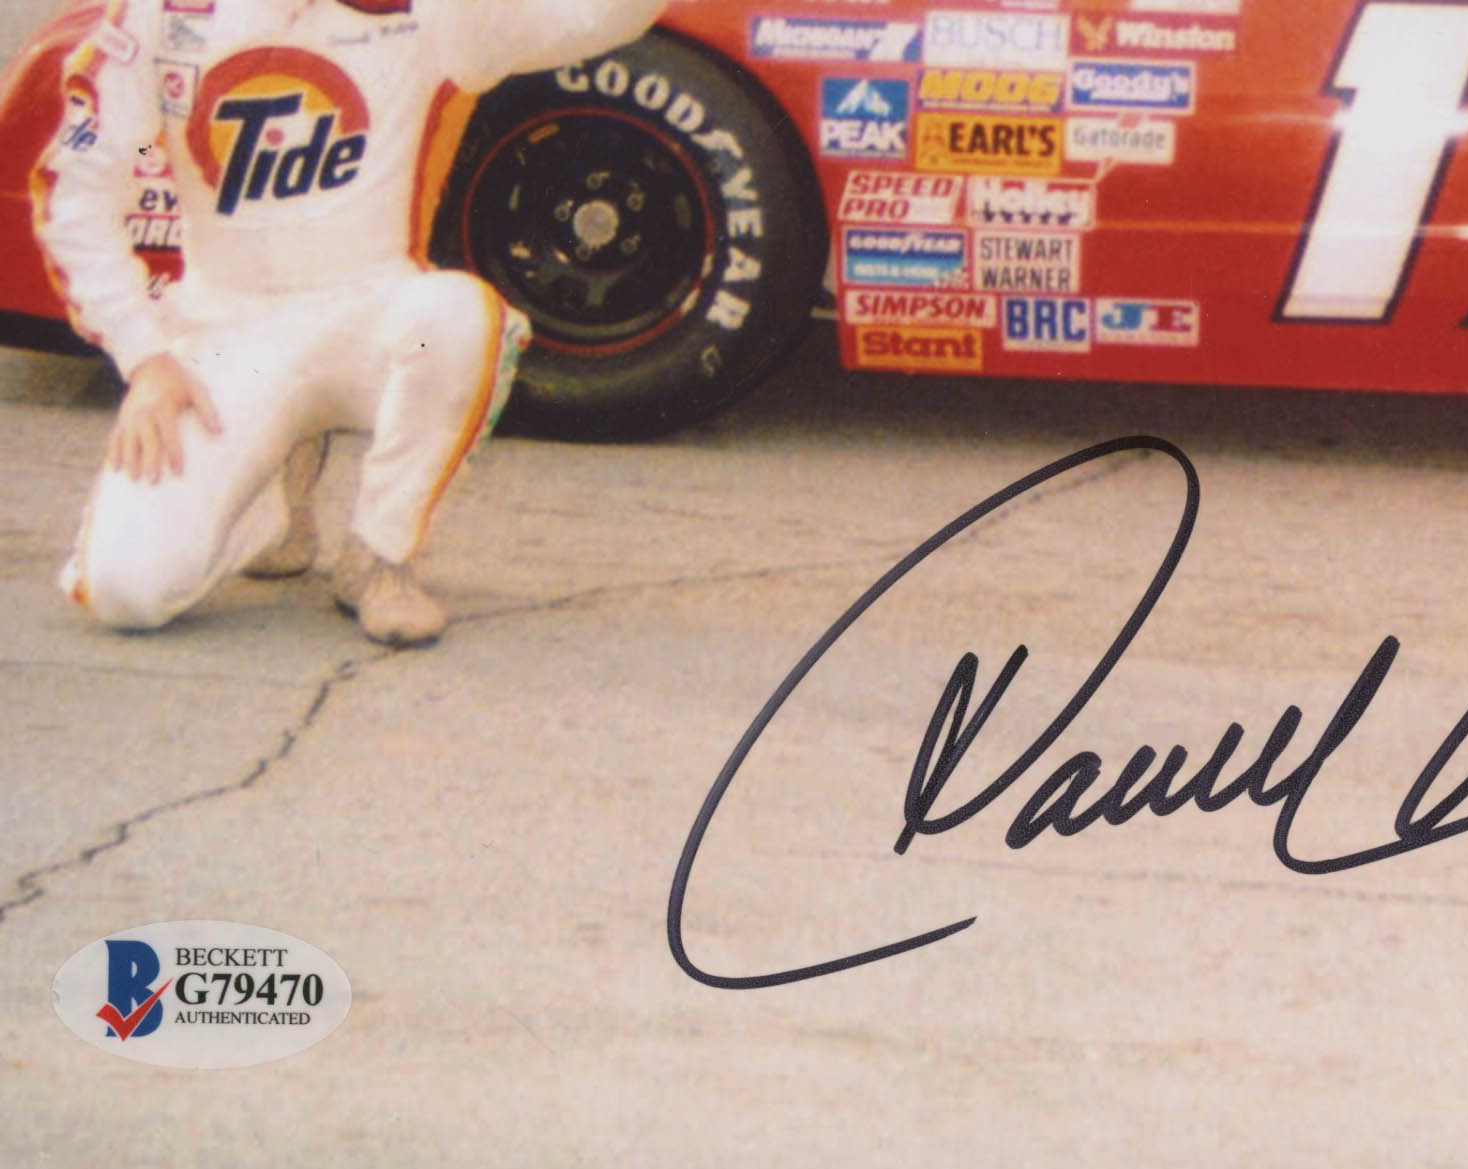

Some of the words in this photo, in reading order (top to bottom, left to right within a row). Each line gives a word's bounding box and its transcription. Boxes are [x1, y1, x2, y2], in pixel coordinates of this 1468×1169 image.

[931, 16, 1064, 51] BUSCH
[1115, 21, 1236, 51] Winston
[920, 71, 1062, 104] MOOG
[822, 119, 906, 151] PEAK
[949, 122, 1055, 157] EARL'S
[1072, 125, 1166, 150] Gatorade
[214, 92, 367, 217] Tide
[555, 58, 765, 330] GOODYEAR
[849, 173, 954, 198] SPEED
[843, 197, 909, 219] PRO
[980, 237, 1073, 261] STEWART
[981, 266, 1072, 291] WARNER
[855, 293, 987, 319] SIMPSON
[1006, 298, 1087, 341] BRC
[862, 330, 976, 359] Stant
